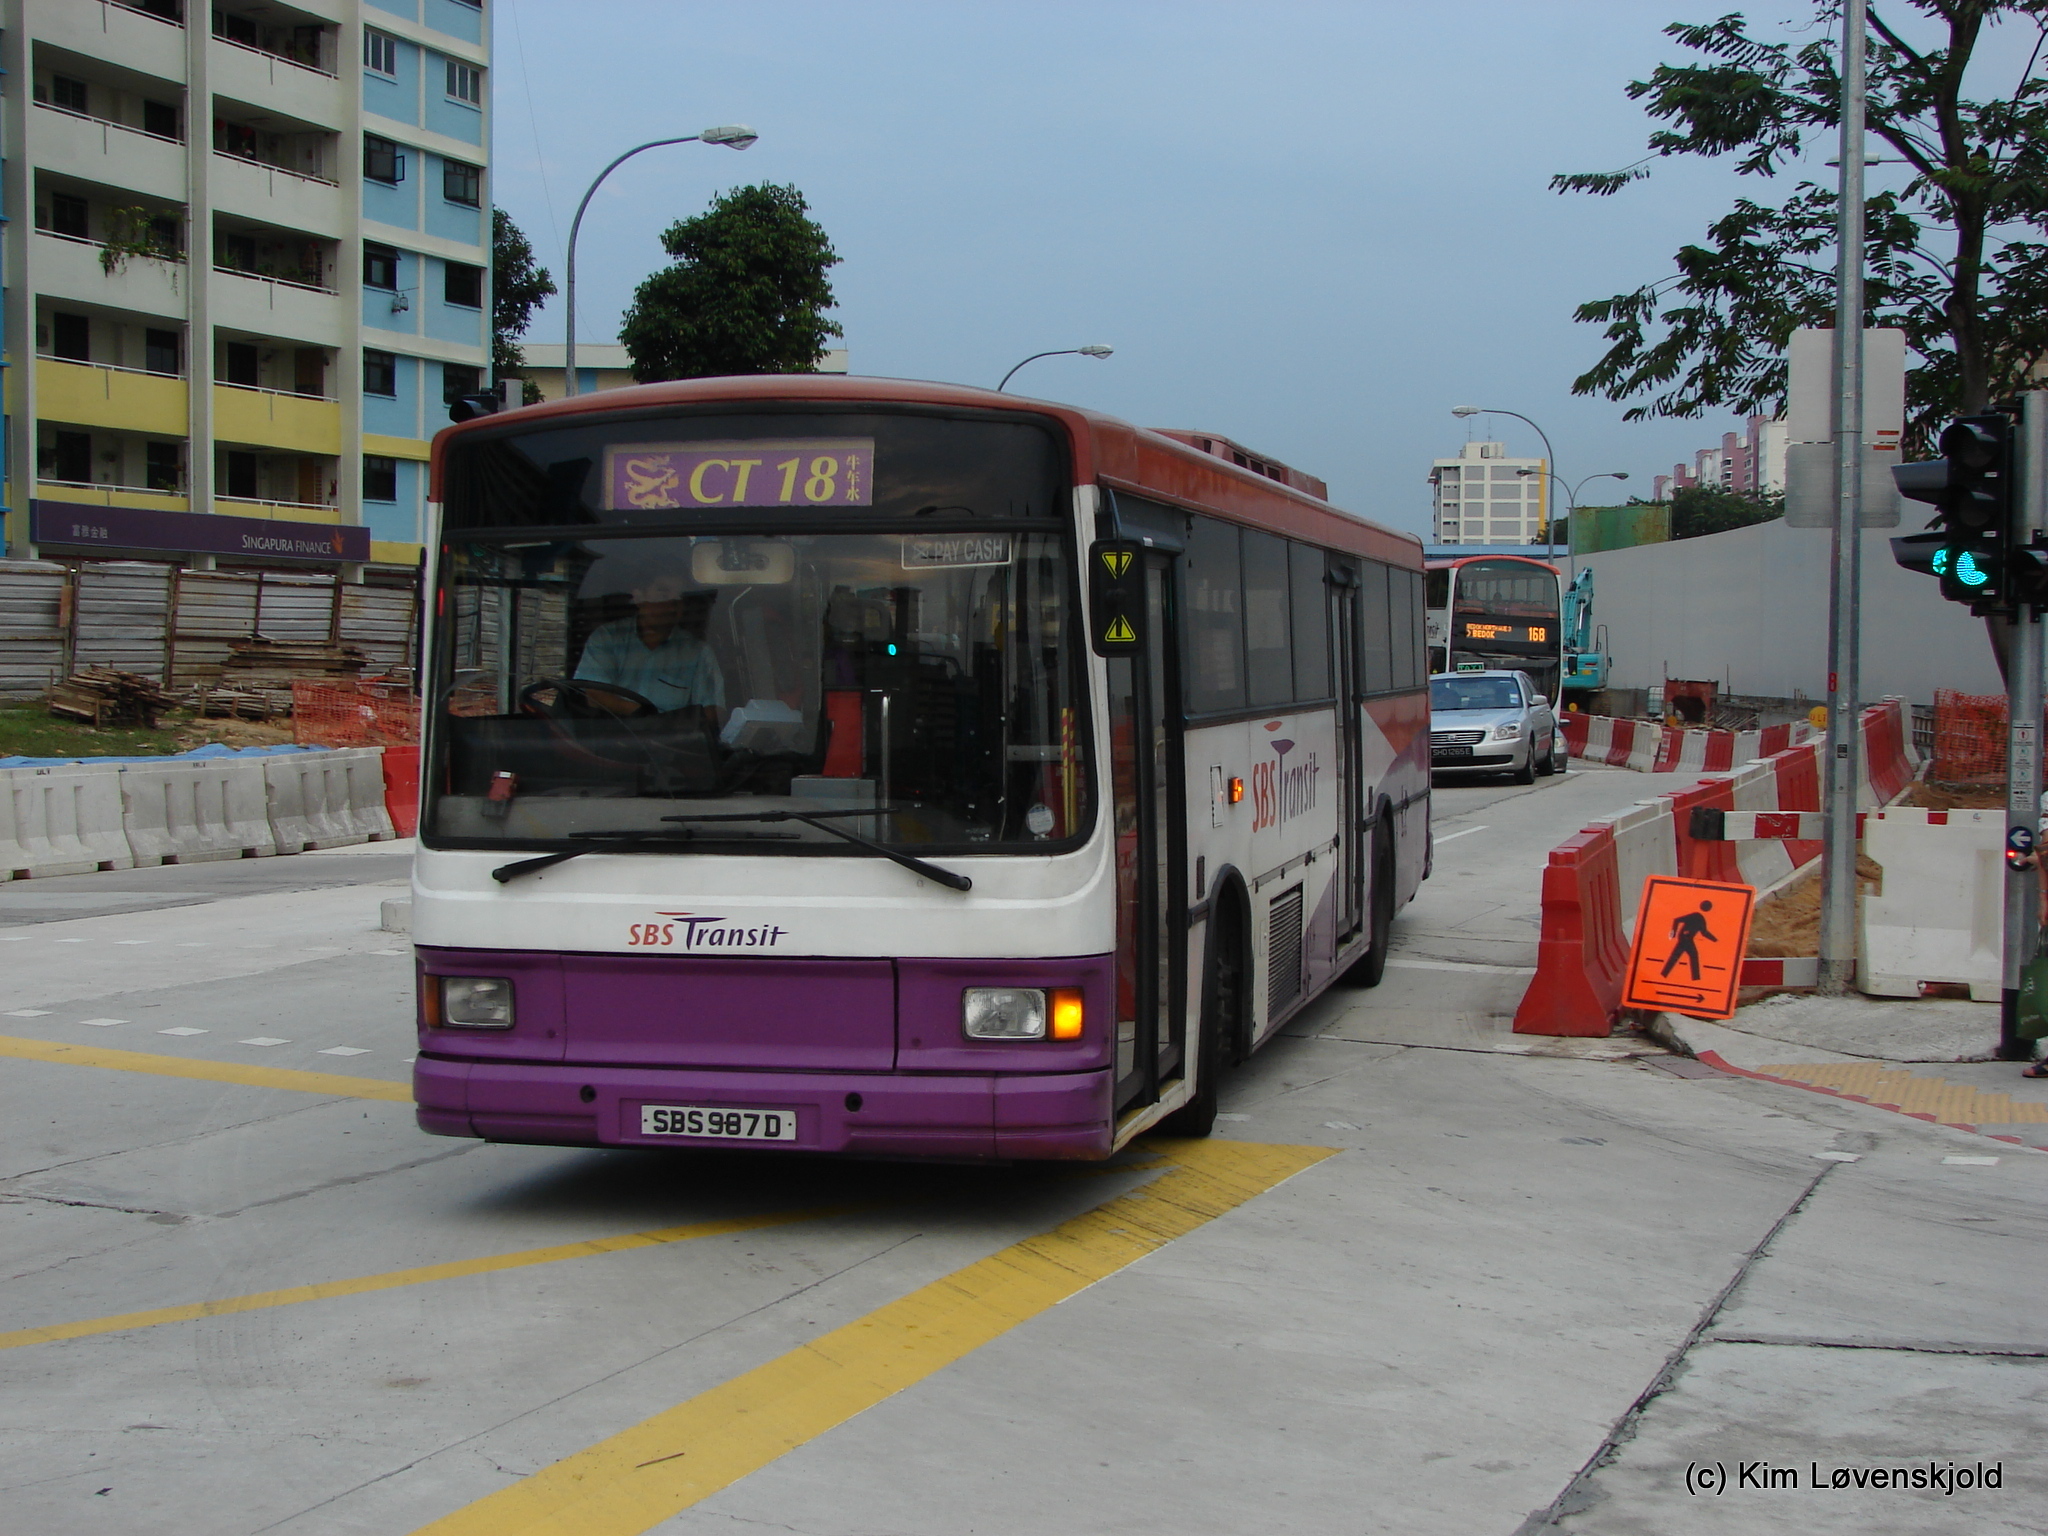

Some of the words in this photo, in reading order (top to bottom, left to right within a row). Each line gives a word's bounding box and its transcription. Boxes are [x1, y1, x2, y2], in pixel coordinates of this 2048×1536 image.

[689, 458, 762, 504] CT
[776, 456, 839, 502] 18
[242, 534, 294, 552] SINGAPURA
[295, 540, 331, 554] FINANCE
[934, 540, 960, 562] PAY
[964, 538, 1003, 561] CASH
[1473, 629, 1496, 639] BEDOK
[1528, 627, 1546, 642] 168
[1252, 760, 1276, 833] SBS
[1270, 739, 1320, 839] Transit
[628, 923, 675, 946] SBS
[672, 917, 789, 951] Transit
